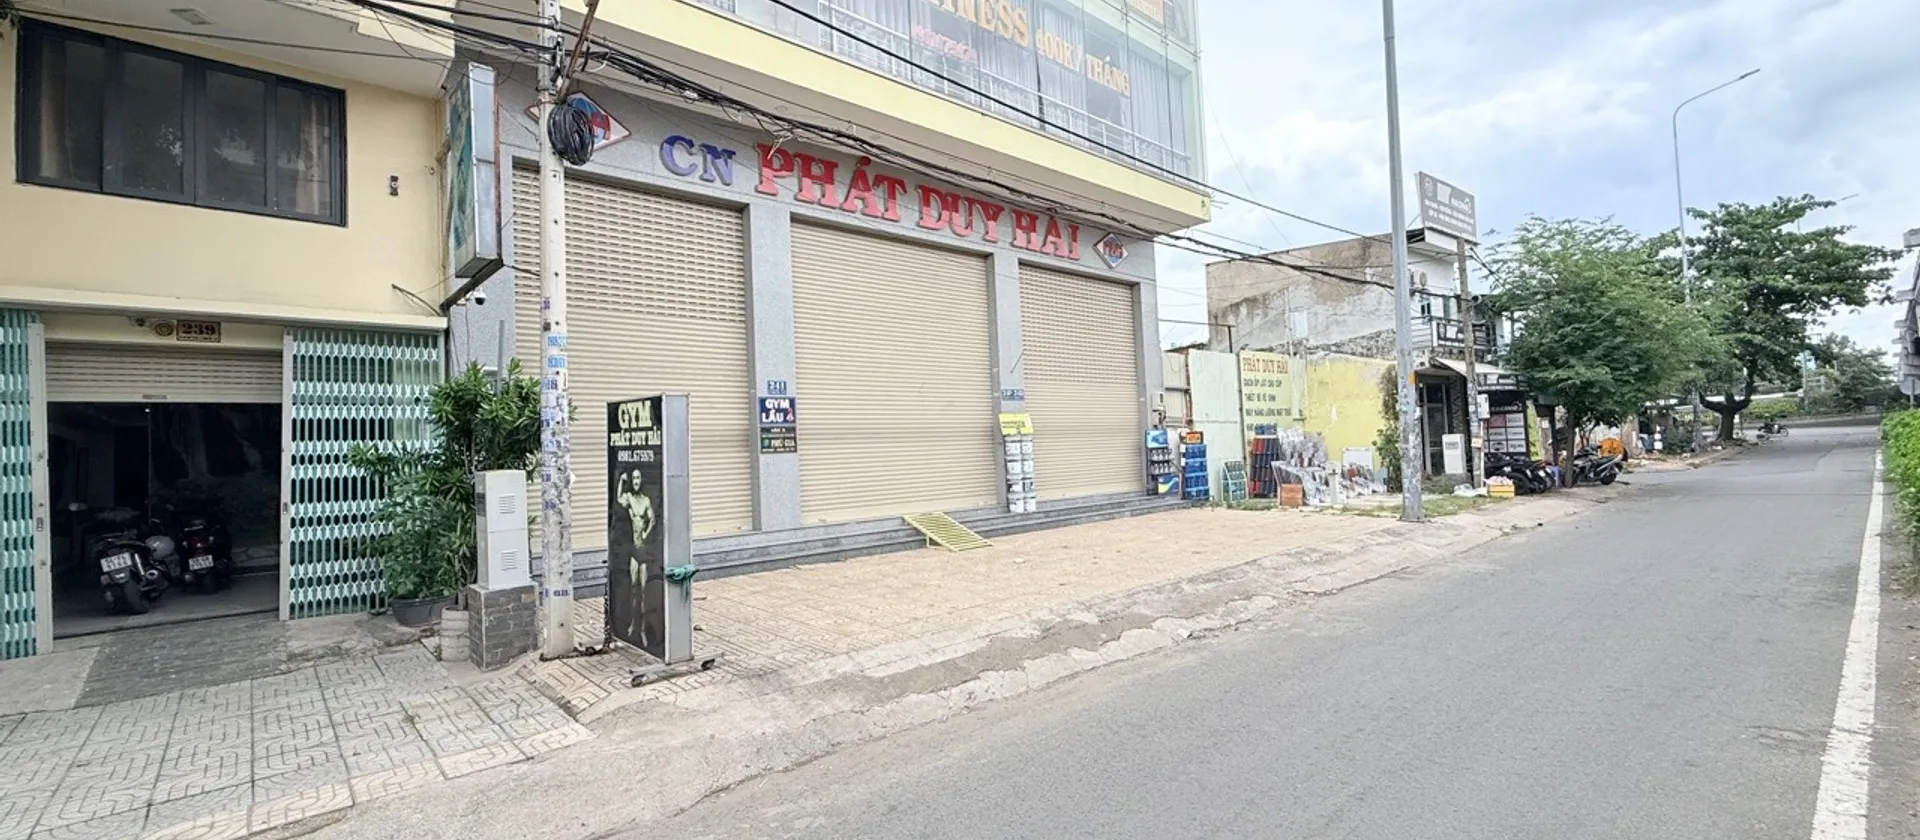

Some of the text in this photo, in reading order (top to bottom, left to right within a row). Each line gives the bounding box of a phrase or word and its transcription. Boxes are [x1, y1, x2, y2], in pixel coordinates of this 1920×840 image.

[659, 134, 736, 187] CN
[755, 142, 908, 222] PHÁT
[917, 184, 1004, 243] DUY
[182, 323, 216, 335] 239
[764, 398, 790, 409] GYM
[618, 400, 652, 429] GYM
[610, 428, 630, 447] PHÁT
[631, 430, 646, 446] DUY
